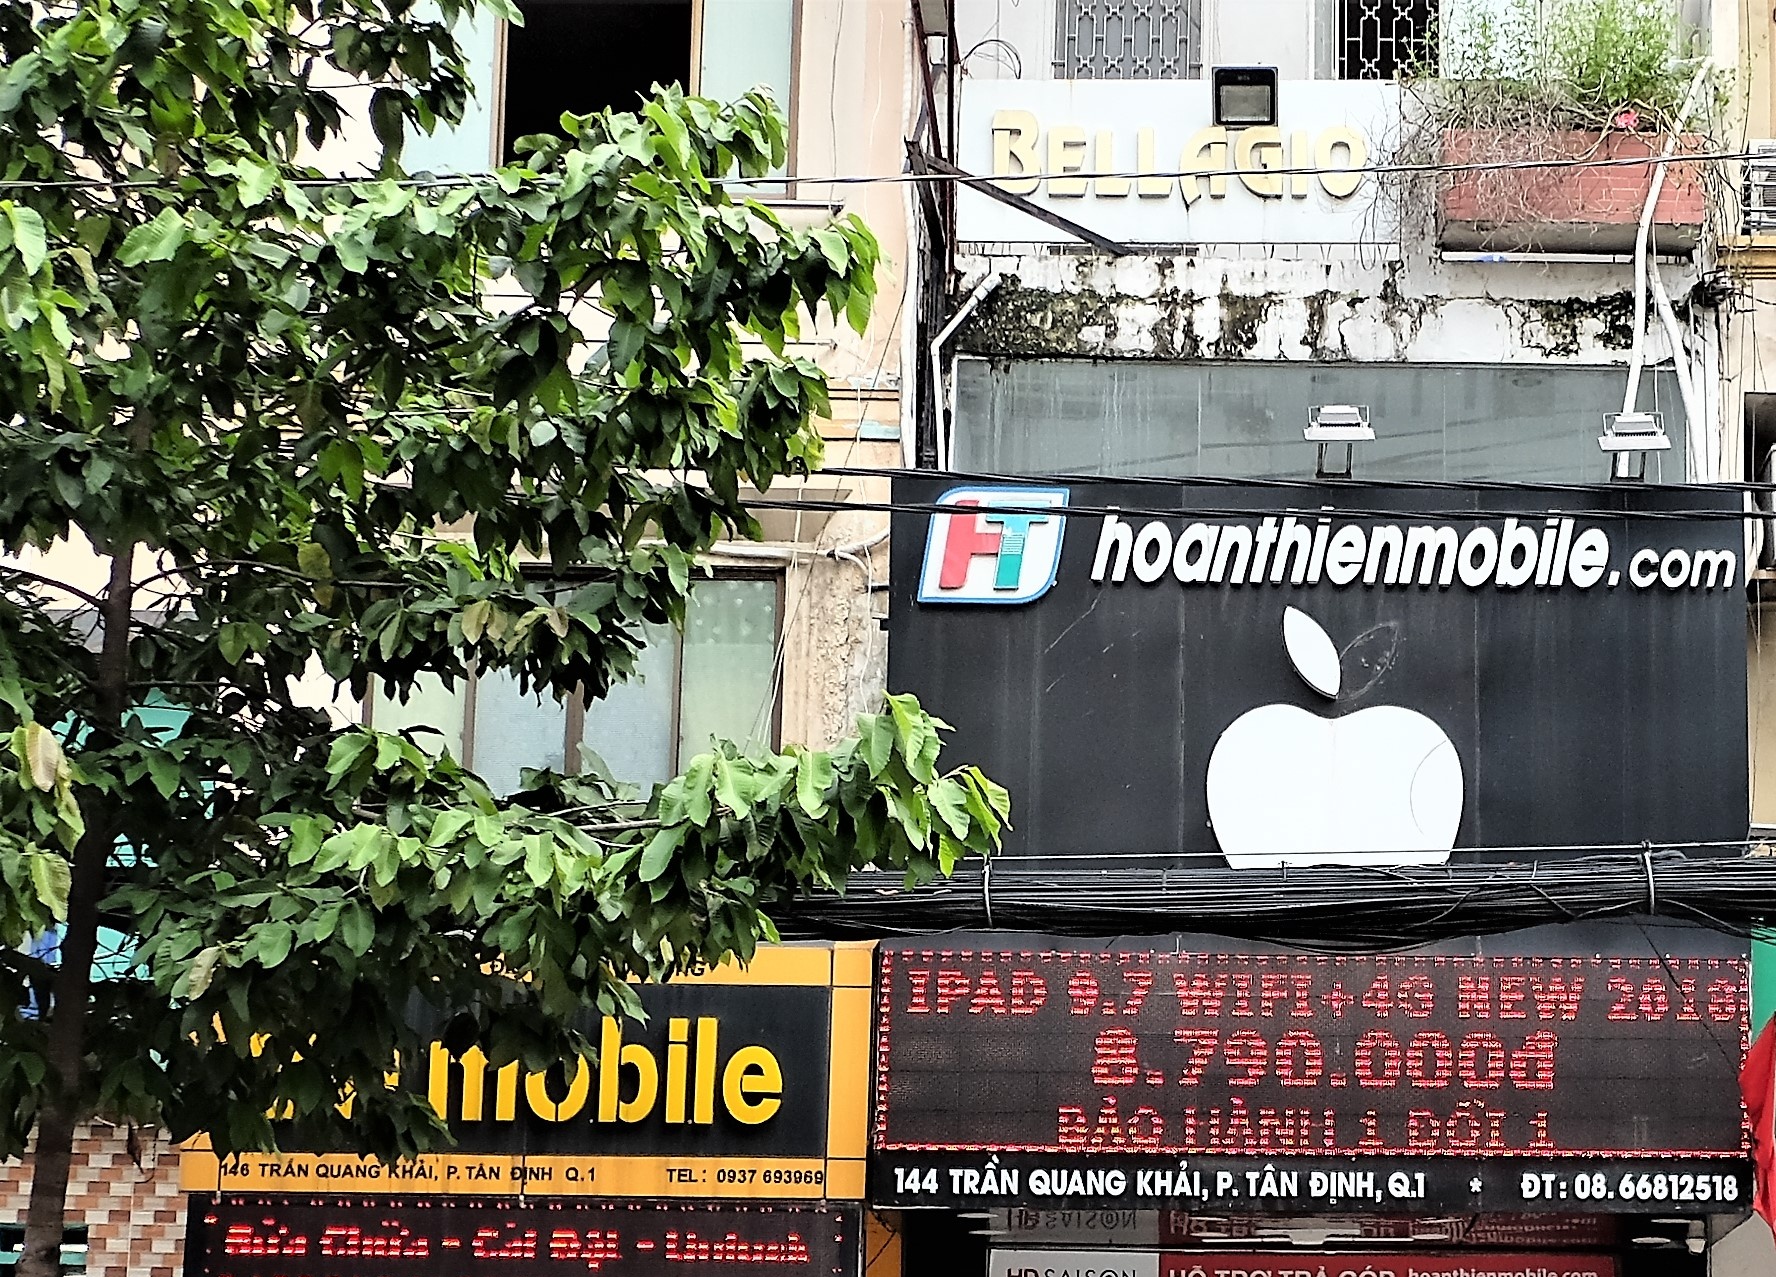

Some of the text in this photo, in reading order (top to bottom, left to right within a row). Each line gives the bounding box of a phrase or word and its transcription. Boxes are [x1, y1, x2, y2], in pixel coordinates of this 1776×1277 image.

[991, 108, 1368, 208] BELLAGIO
[905, 968, 1048, 1016] IPAD
[1067, 969, 1154, 1017] 9.7
[1456, 975, 1586, 1020] NEW
[1091, 1027, 1557, 1091] 8.790.000đ
[1057, 1096, 1161, 1151] BẢO
[1185, 1097, 1337, 1150] HÀNH
[1360, 1109, 1384, 1148] 1
[1529, 1110, 1556, 1150] 1
[220, 1163, 250, 1178] 146
[259, 1158, 309, 1178] TRẦN
[316, 1163, 381, 1180] QUANG
[388, 1158, 438, 1182] KHẢI,
[446, 1165, 460, 1180] P.
[466, 1161, 501, 1181] TÂN
[510, 1166, 553, 1186] ĐỊNH
[565, 1166, 596, 1183] Q.1
[716, 1168, 757, 1184] 0937
[762, 1169, 825, 1185] 693969
[894, 1168, 938, 1196] 144
[949, 1154, 1020, 1197] TRẦN
[1028, 1169, 1127, 1198] QUANG
[1136, 1160, 1210, 1200] KHẢI,
[1216, 1172, 1240, 1198] P.
[1246, 1163, 1300, 1198] TÂN
[1308, 1171, 1384, 1205] ĐỊNH,
[1386, 1172, 1426, 1201] Q.1
